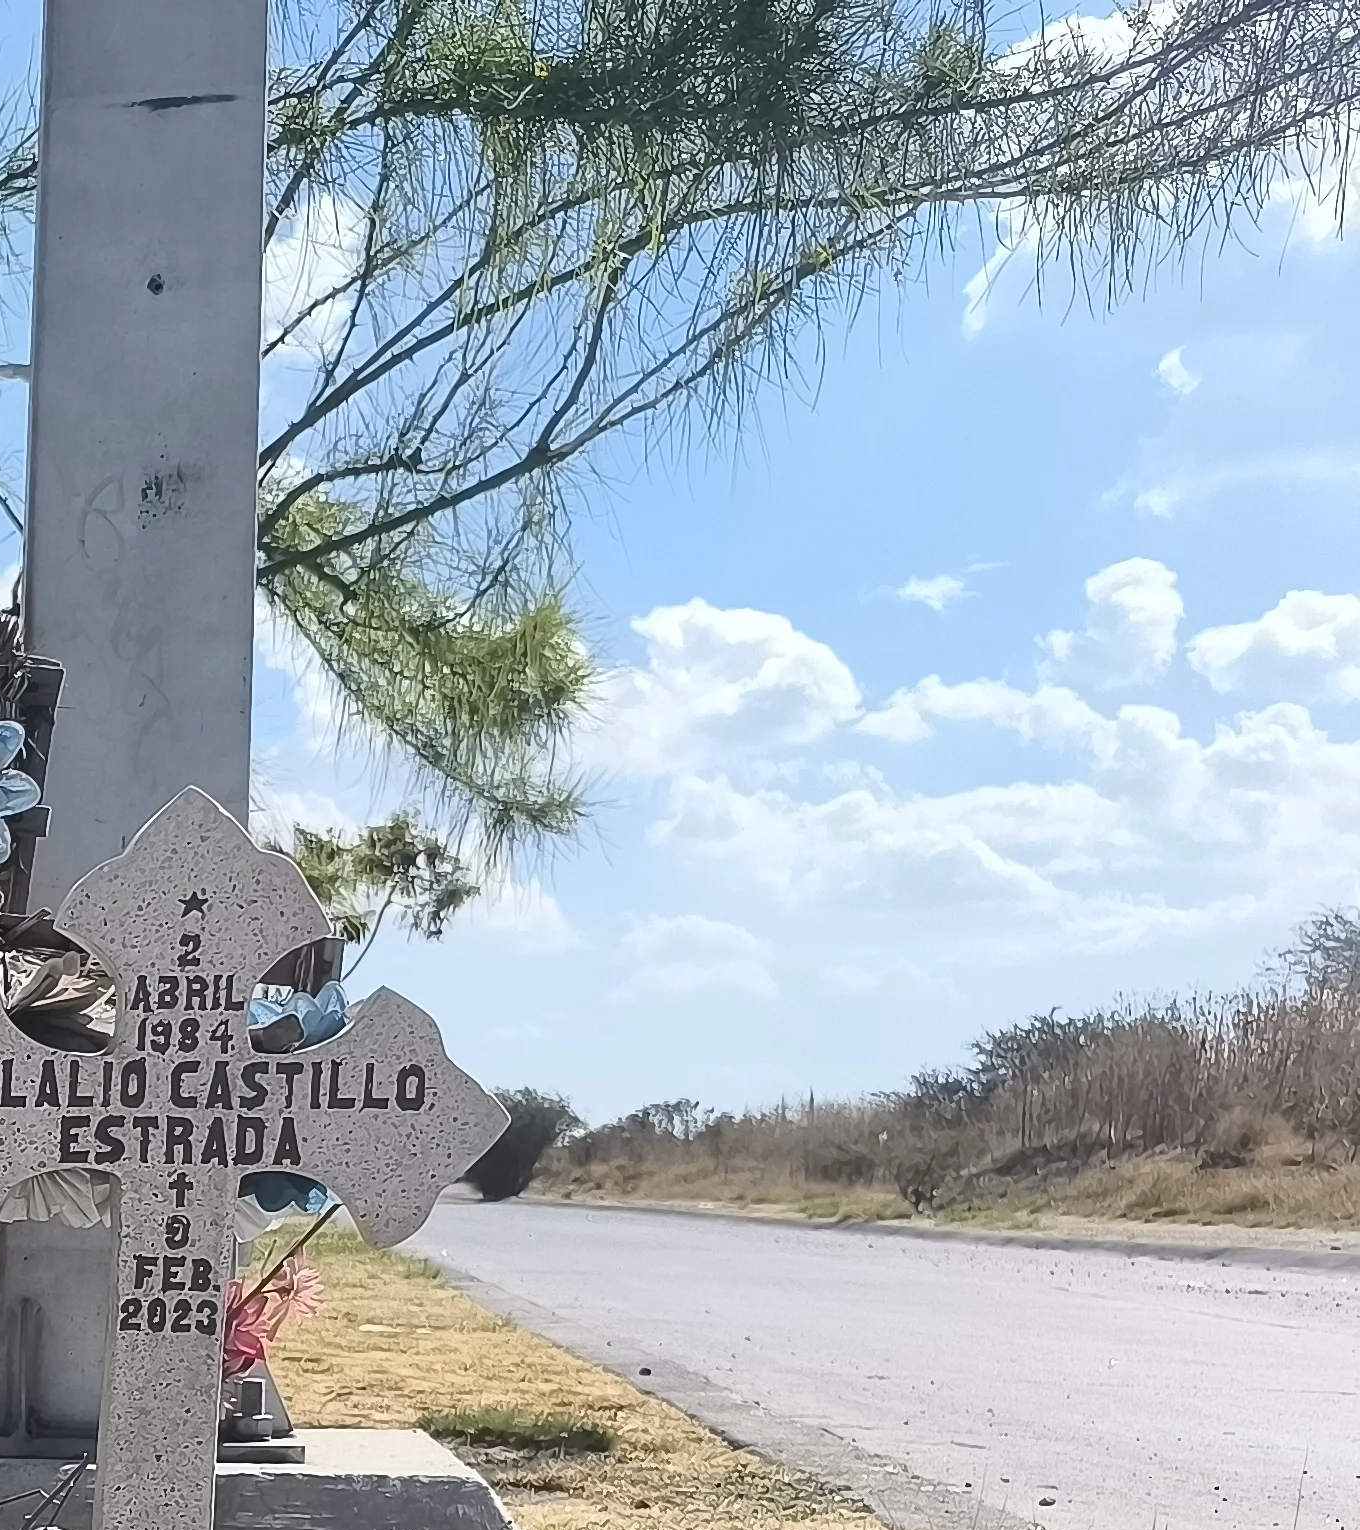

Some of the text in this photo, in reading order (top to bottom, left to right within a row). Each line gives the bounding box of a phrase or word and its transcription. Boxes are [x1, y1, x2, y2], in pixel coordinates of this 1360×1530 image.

[176, 932, 202, 969] 2
[129, 972, 246, 1015] ABRIL
[135, 1015, 235, 1056] 1984
[166, 1058, 426, 1114] CASTILLO
[57, 1113, 302, 1168] ESTRADA
[132, 1253, 221, 1295] FEB.
[118, 1296, 219, 1338] 2023
